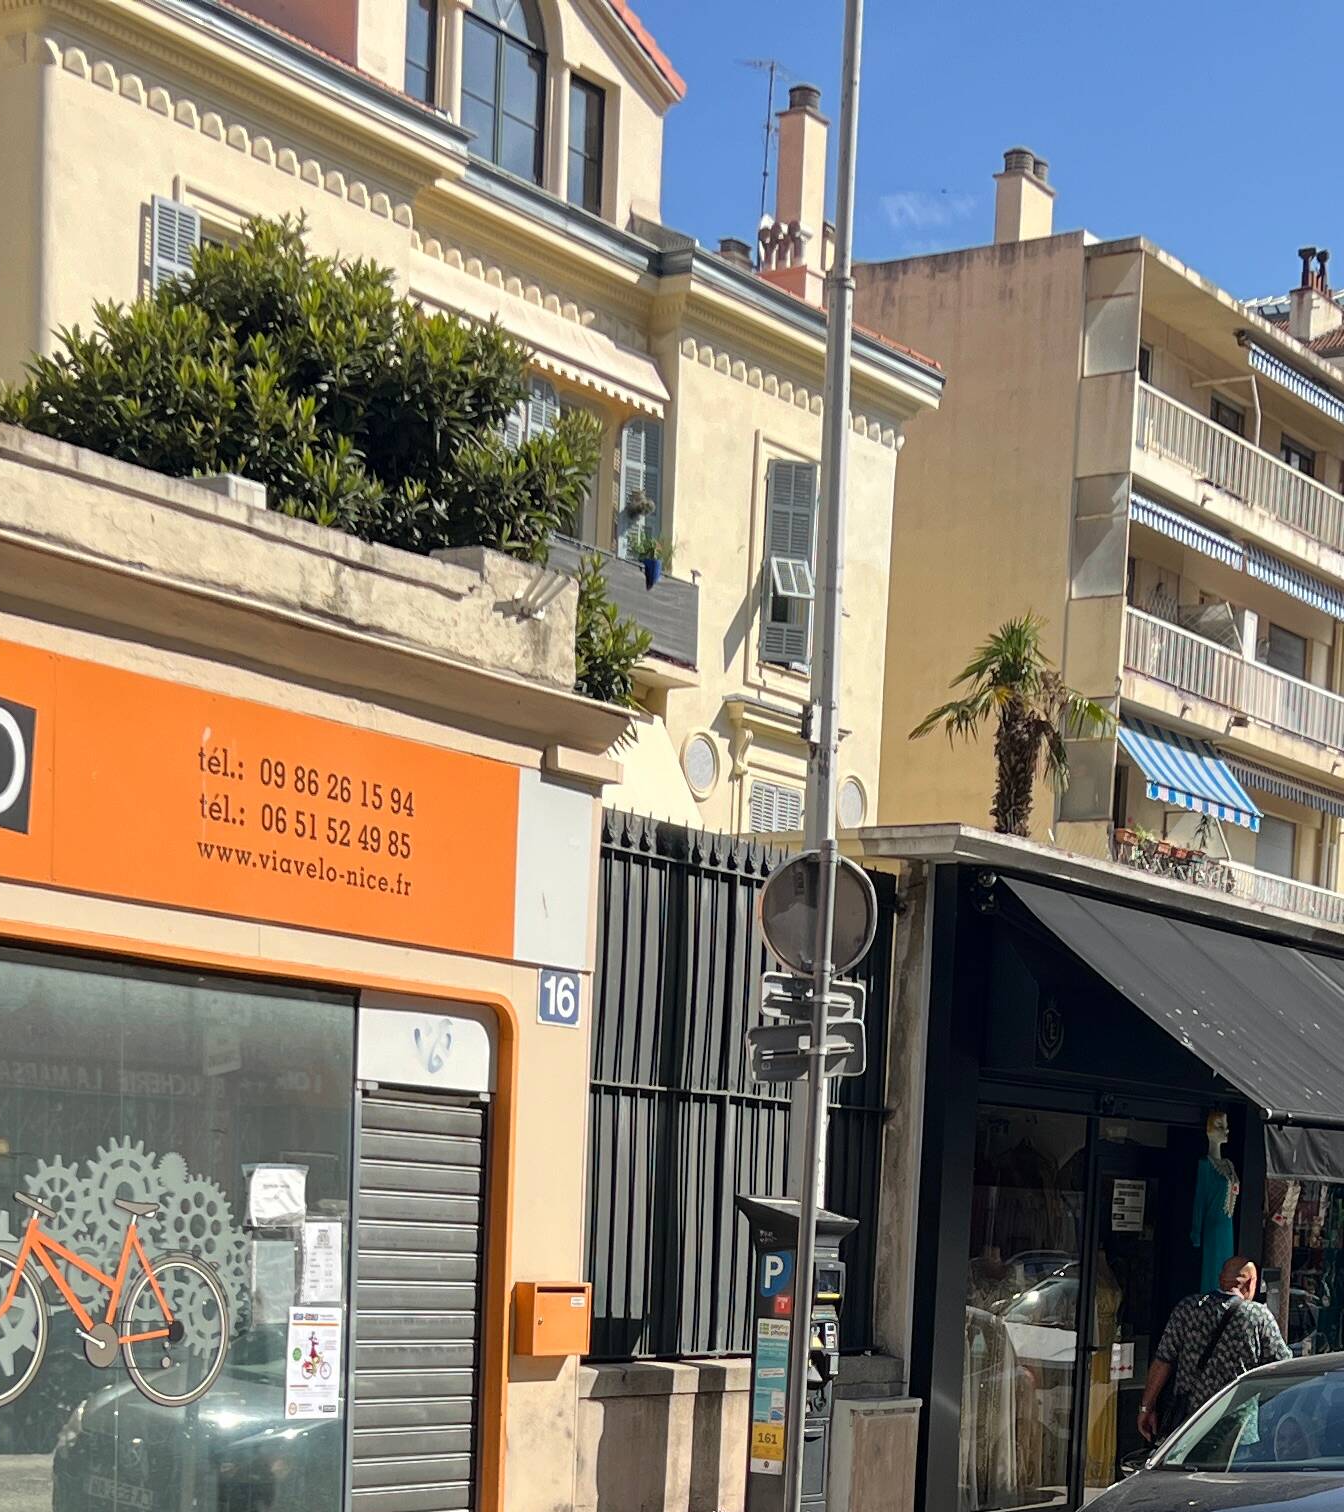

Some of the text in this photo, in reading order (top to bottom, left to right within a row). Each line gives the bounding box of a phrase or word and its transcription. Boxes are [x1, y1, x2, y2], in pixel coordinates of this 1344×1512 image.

[260, 758, 286, 789] 09
[294, 765, 319, 796] 86
[327, 773, 351, 803] 26
[361, 781, 383, 810] 15
[391, 788, 414, 817] 94
[261, 803, 287, 834] 06
[294, 810, 317, 841] 51
[326, 817, 351, 847] 52
[358, 824, 381, 853] 49
[388, 830, 411, 859] 85
[197, 840, 411, 897] www.viavelo-nice.fr
[544, 976, 575, 1019] 16
[765, 1255, 784, 1289] P
[757, 1432, 778, 1445] 161
